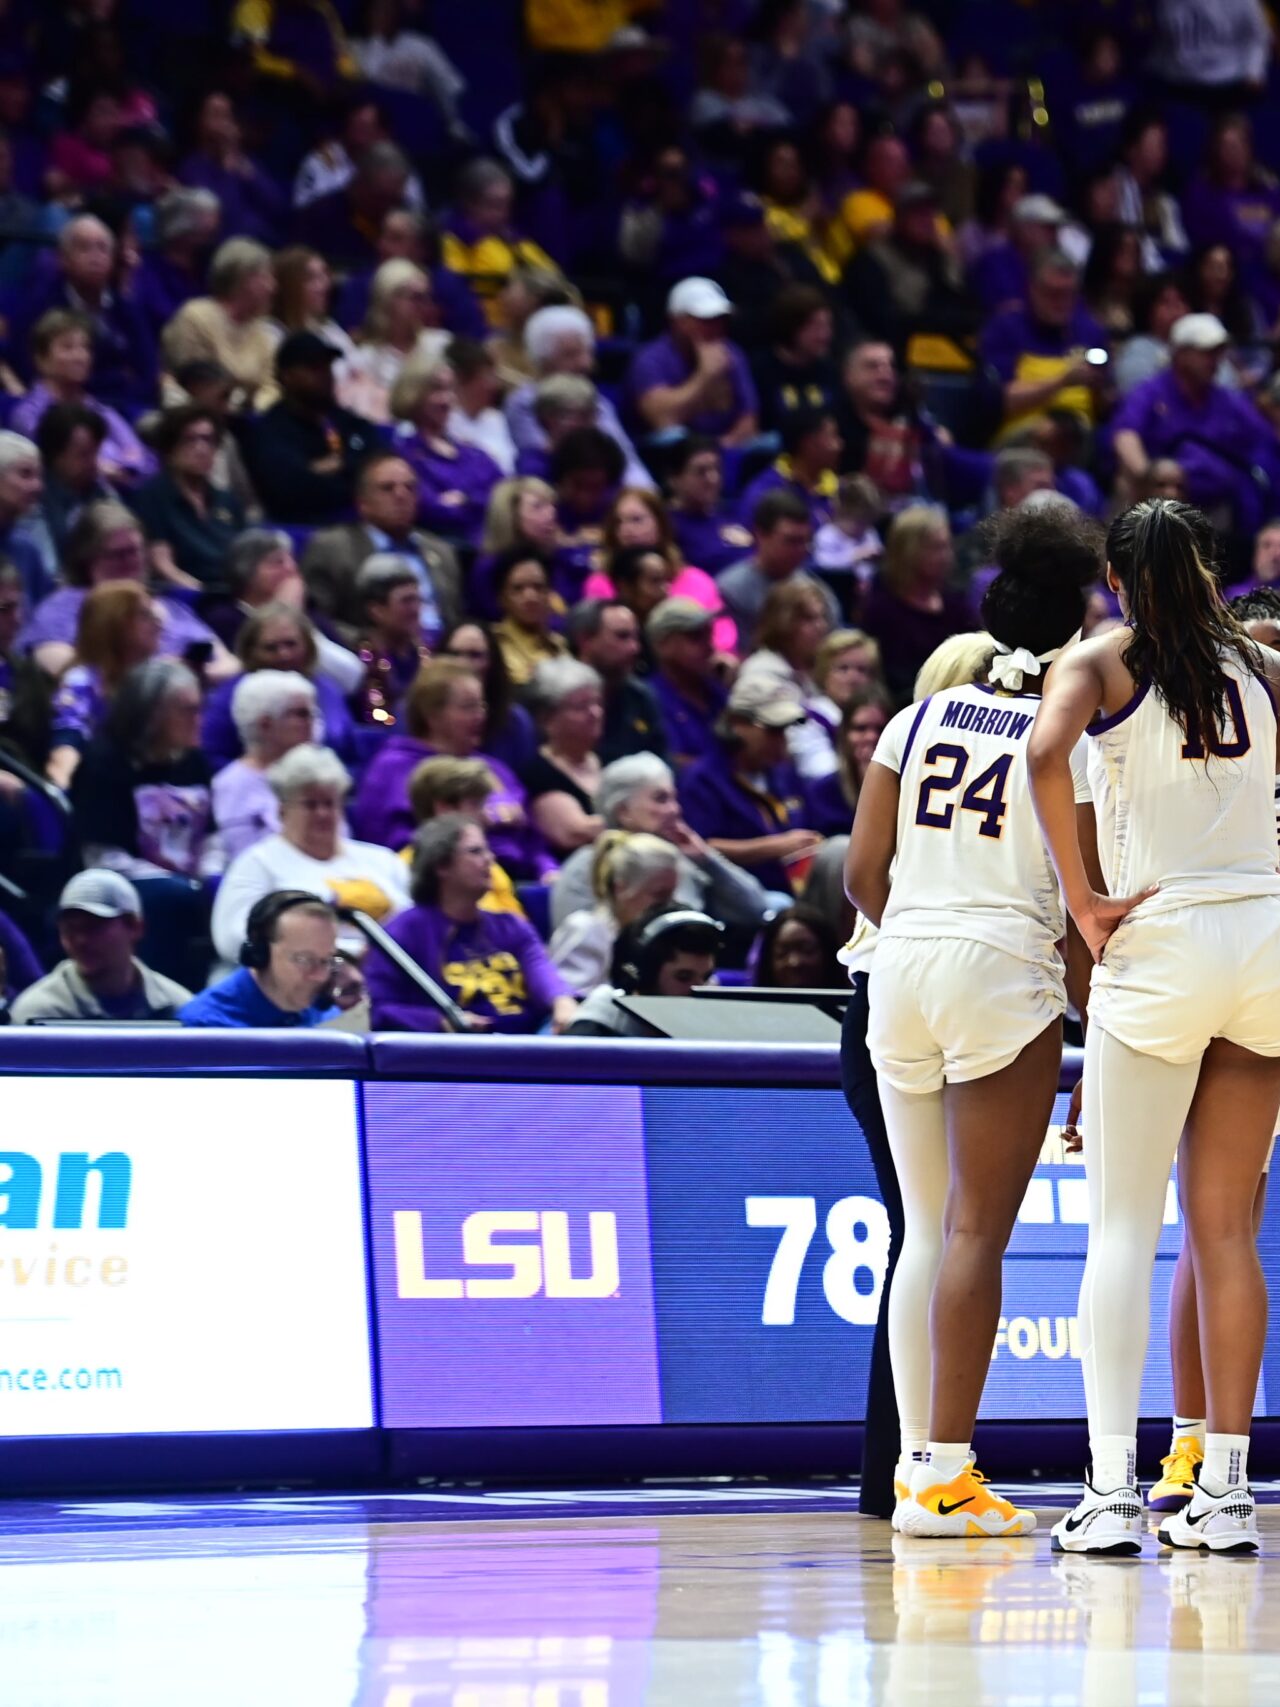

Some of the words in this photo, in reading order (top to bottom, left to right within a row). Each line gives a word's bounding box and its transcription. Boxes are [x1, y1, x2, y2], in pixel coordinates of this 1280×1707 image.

[940, 701, 1034, 740] MORROW
[915, 742, 1014, 838] 24
[0, 1241, 129, 1288] vice
[393, 1210, 620, 1299] LSU
[744, 1195, 891, 1326] 78
